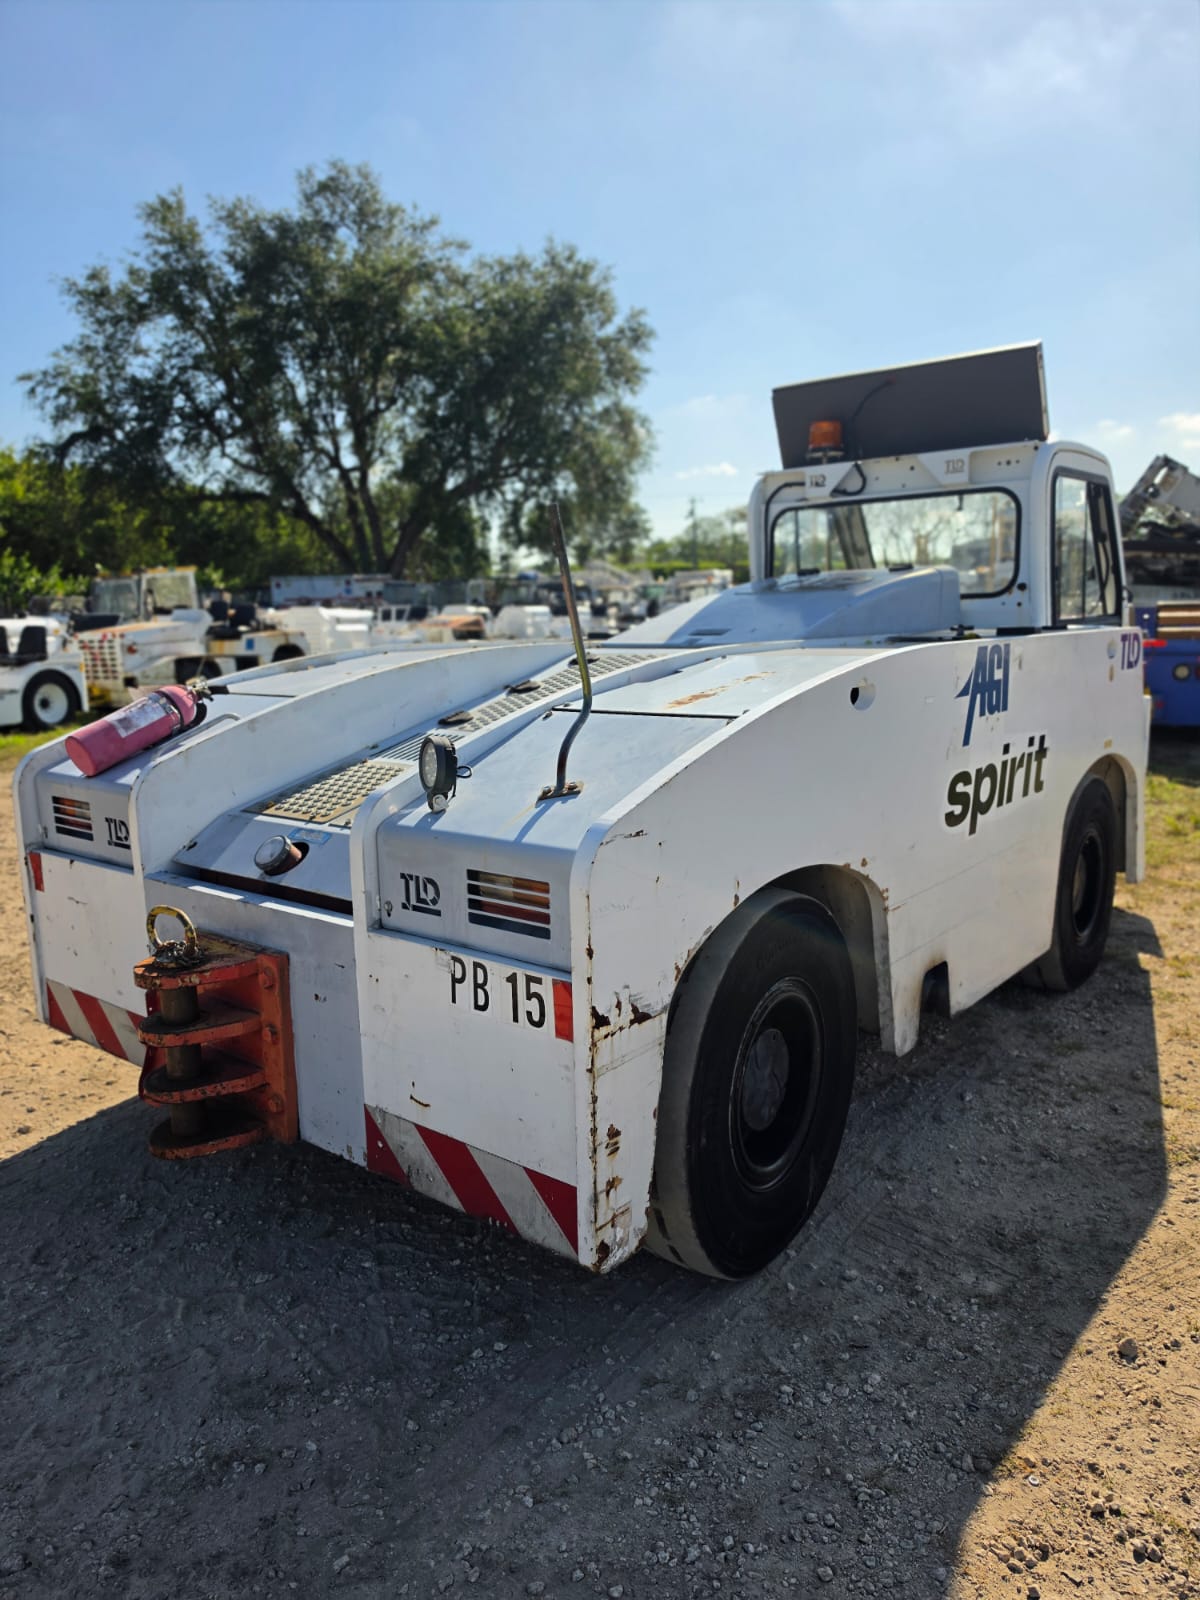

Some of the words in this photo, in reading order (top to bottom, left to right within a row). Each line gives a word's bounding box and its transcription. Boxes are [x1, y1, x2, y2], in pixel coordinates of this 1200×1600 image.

[1121, 633, 1141, 670] TLD
[955, 643, 1010, 747] AGI
[944, 734, 1048, 836] spirit
[105, 817, 131, 849] TLD
[400, 873, 441, 916] TLD
[450, 956, 490, 1012] PB
[506, 971, 546, 1028] 15
